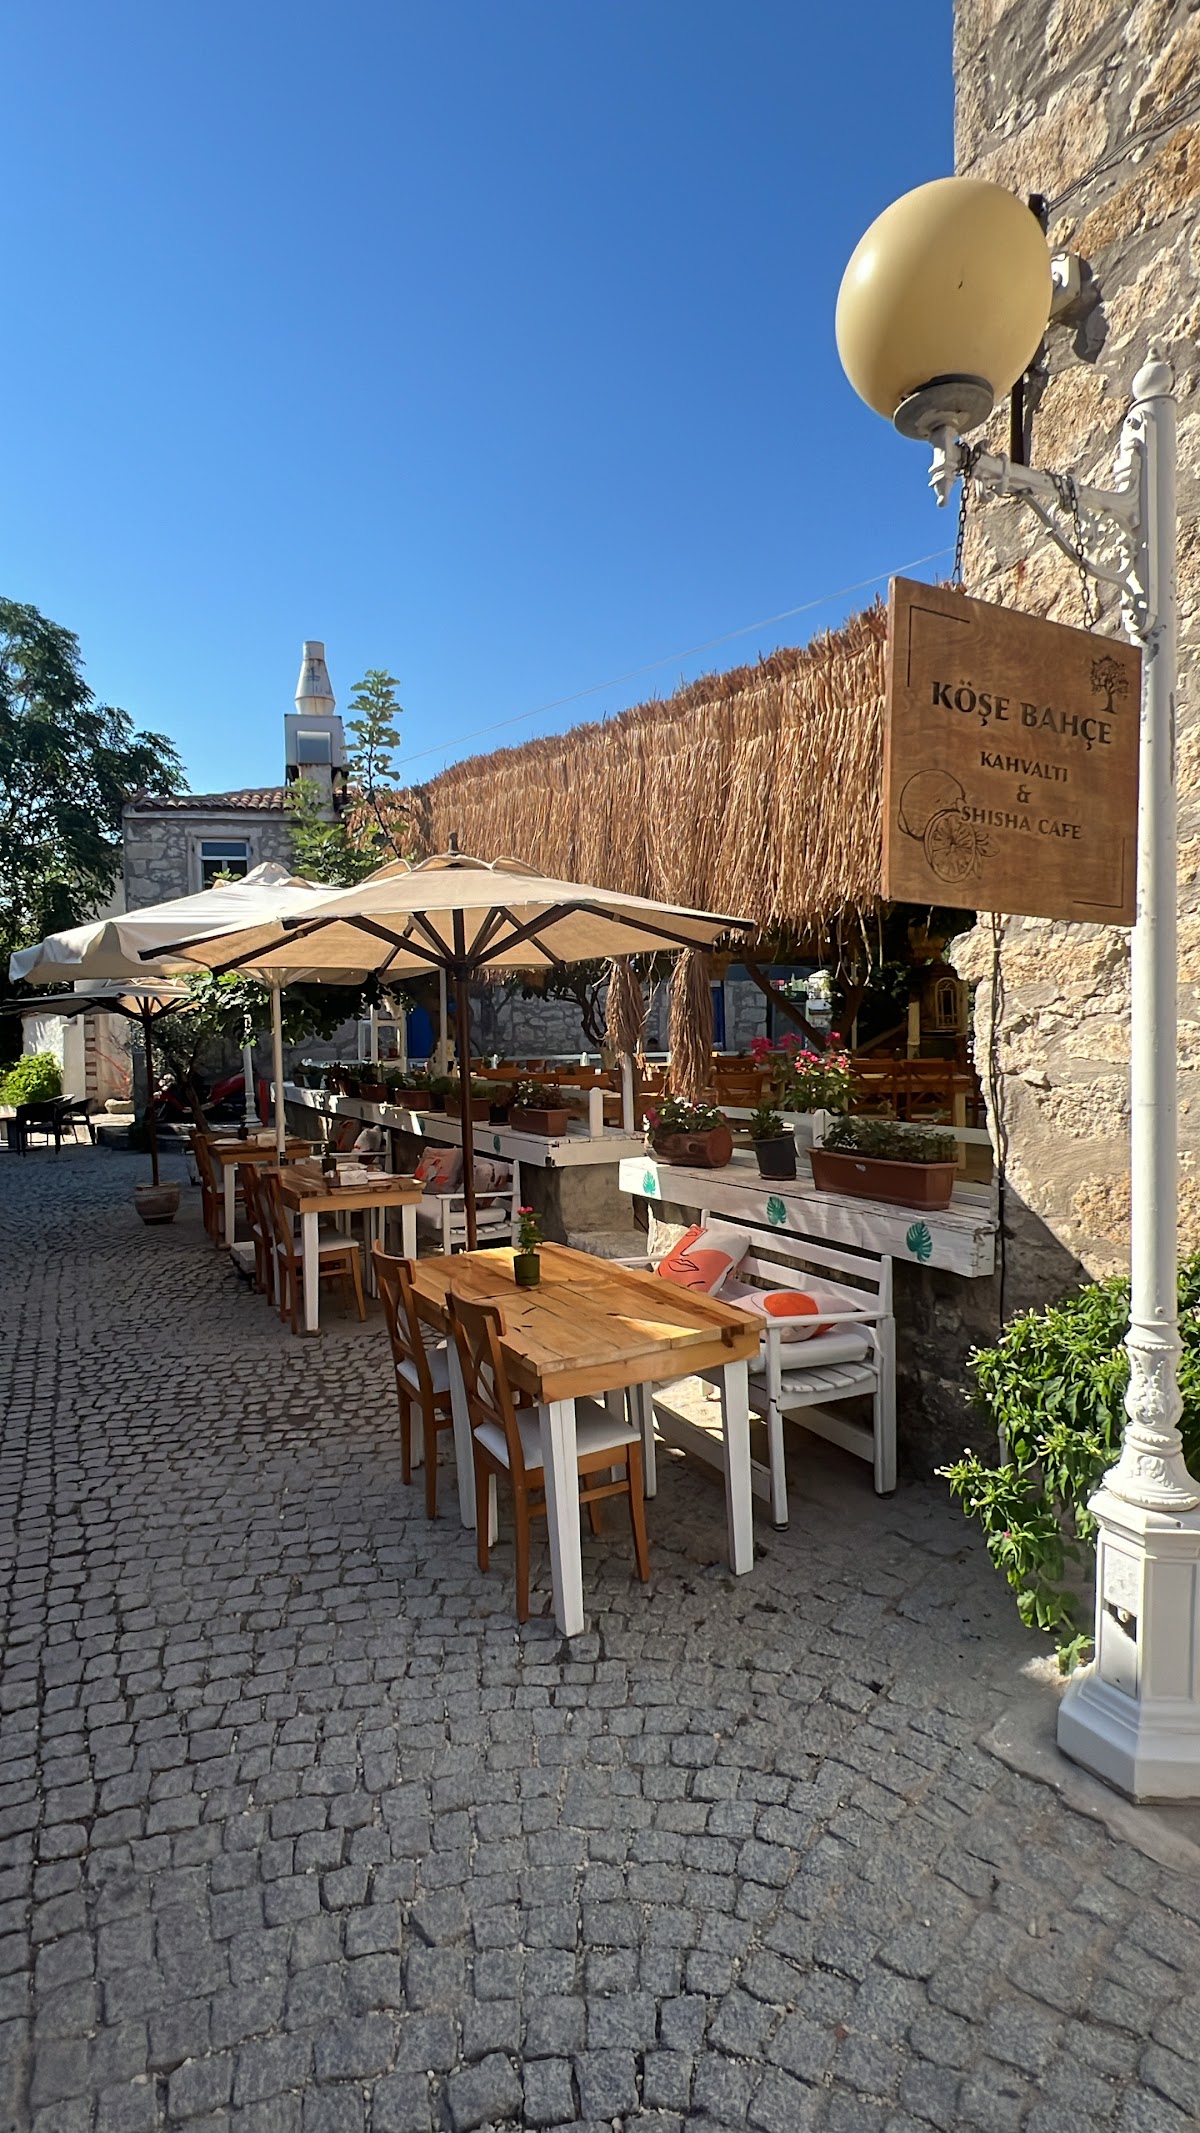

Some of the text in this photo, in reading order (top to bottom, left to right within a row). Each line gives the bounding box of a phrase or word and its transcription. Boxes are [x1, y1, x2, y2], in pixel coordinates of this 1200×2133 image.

[931, 680, 1112, 750] KÖŞE BAHÇE
[980, 751, 1068, 783] KAHVALTI
[1016, 784, 1031, 803] &
[960, 806, 1082, 840] SHISHA CAFE
